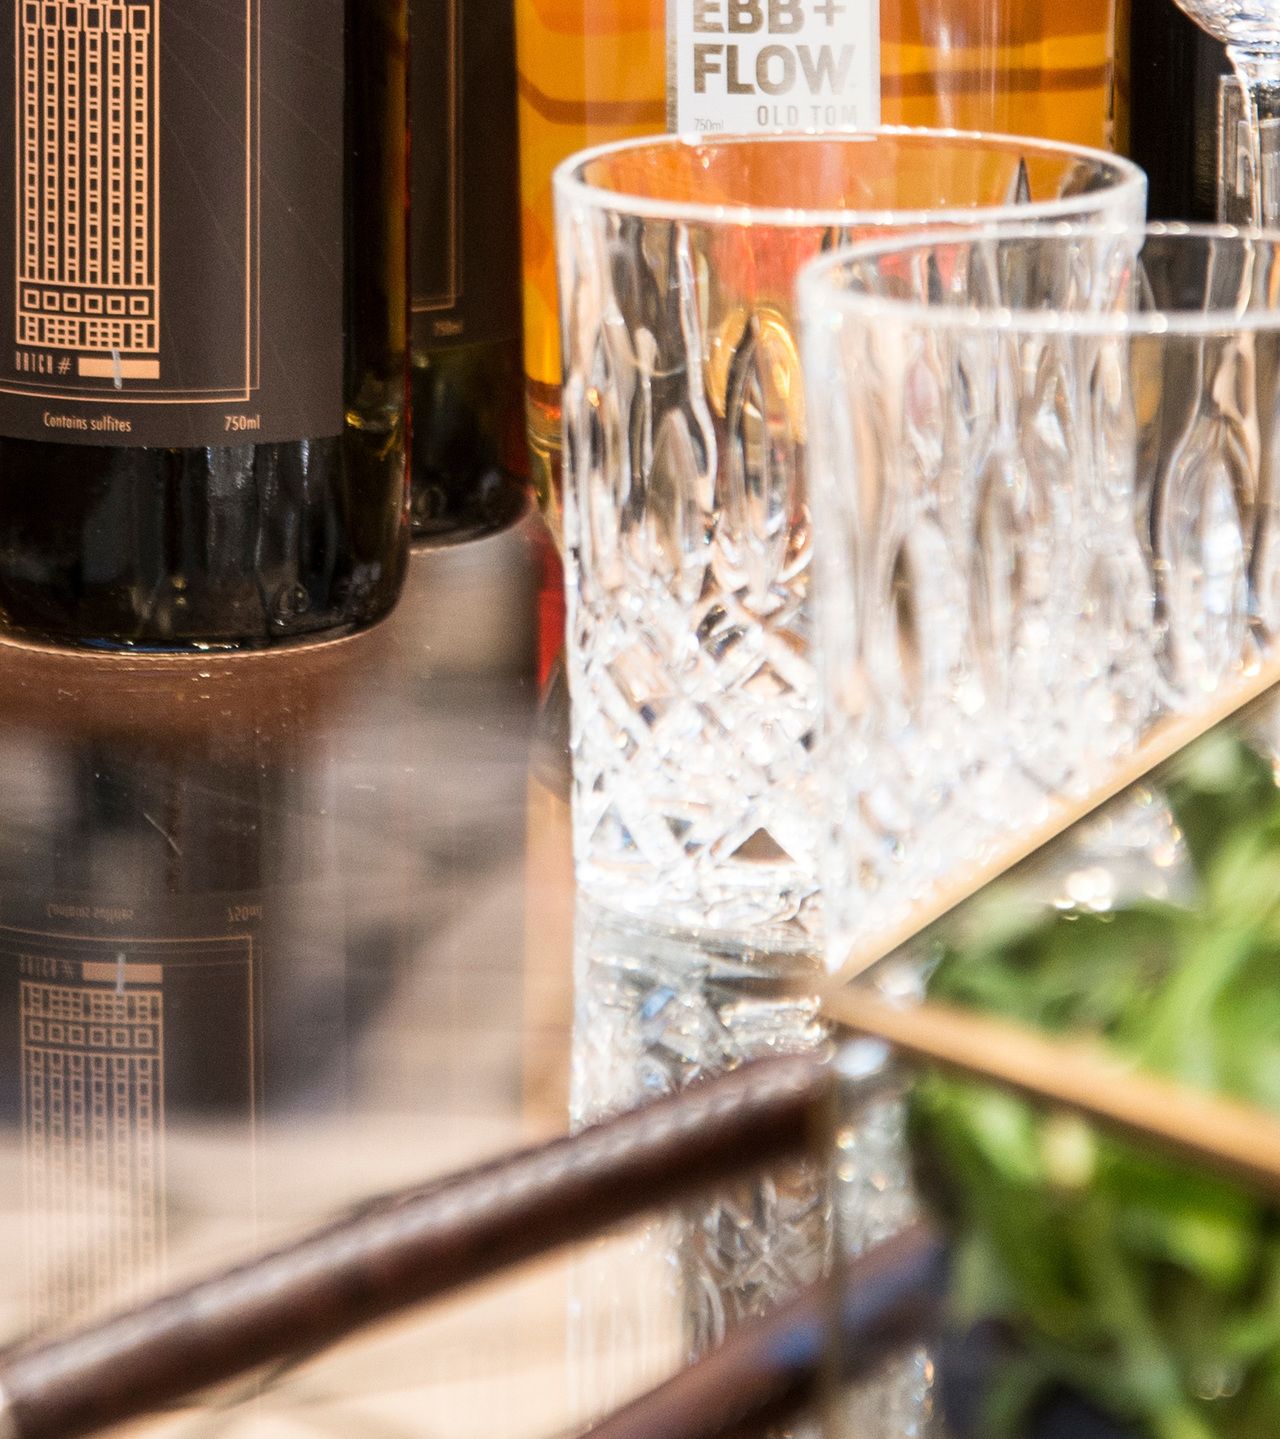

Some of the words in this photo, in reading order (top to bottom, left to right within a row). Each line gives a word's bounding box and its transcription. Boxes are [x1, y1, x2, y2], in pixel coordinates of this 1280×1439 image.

[694, 43, 856, 96] FLOW
[757, 105, 799, 127] OLD
[811, 105, 857, 127] TOM
[44, 411, 88, 429] Contains
[91, 414, 131, 433] sulfites
[224, 414, 260, 431] 750ml
